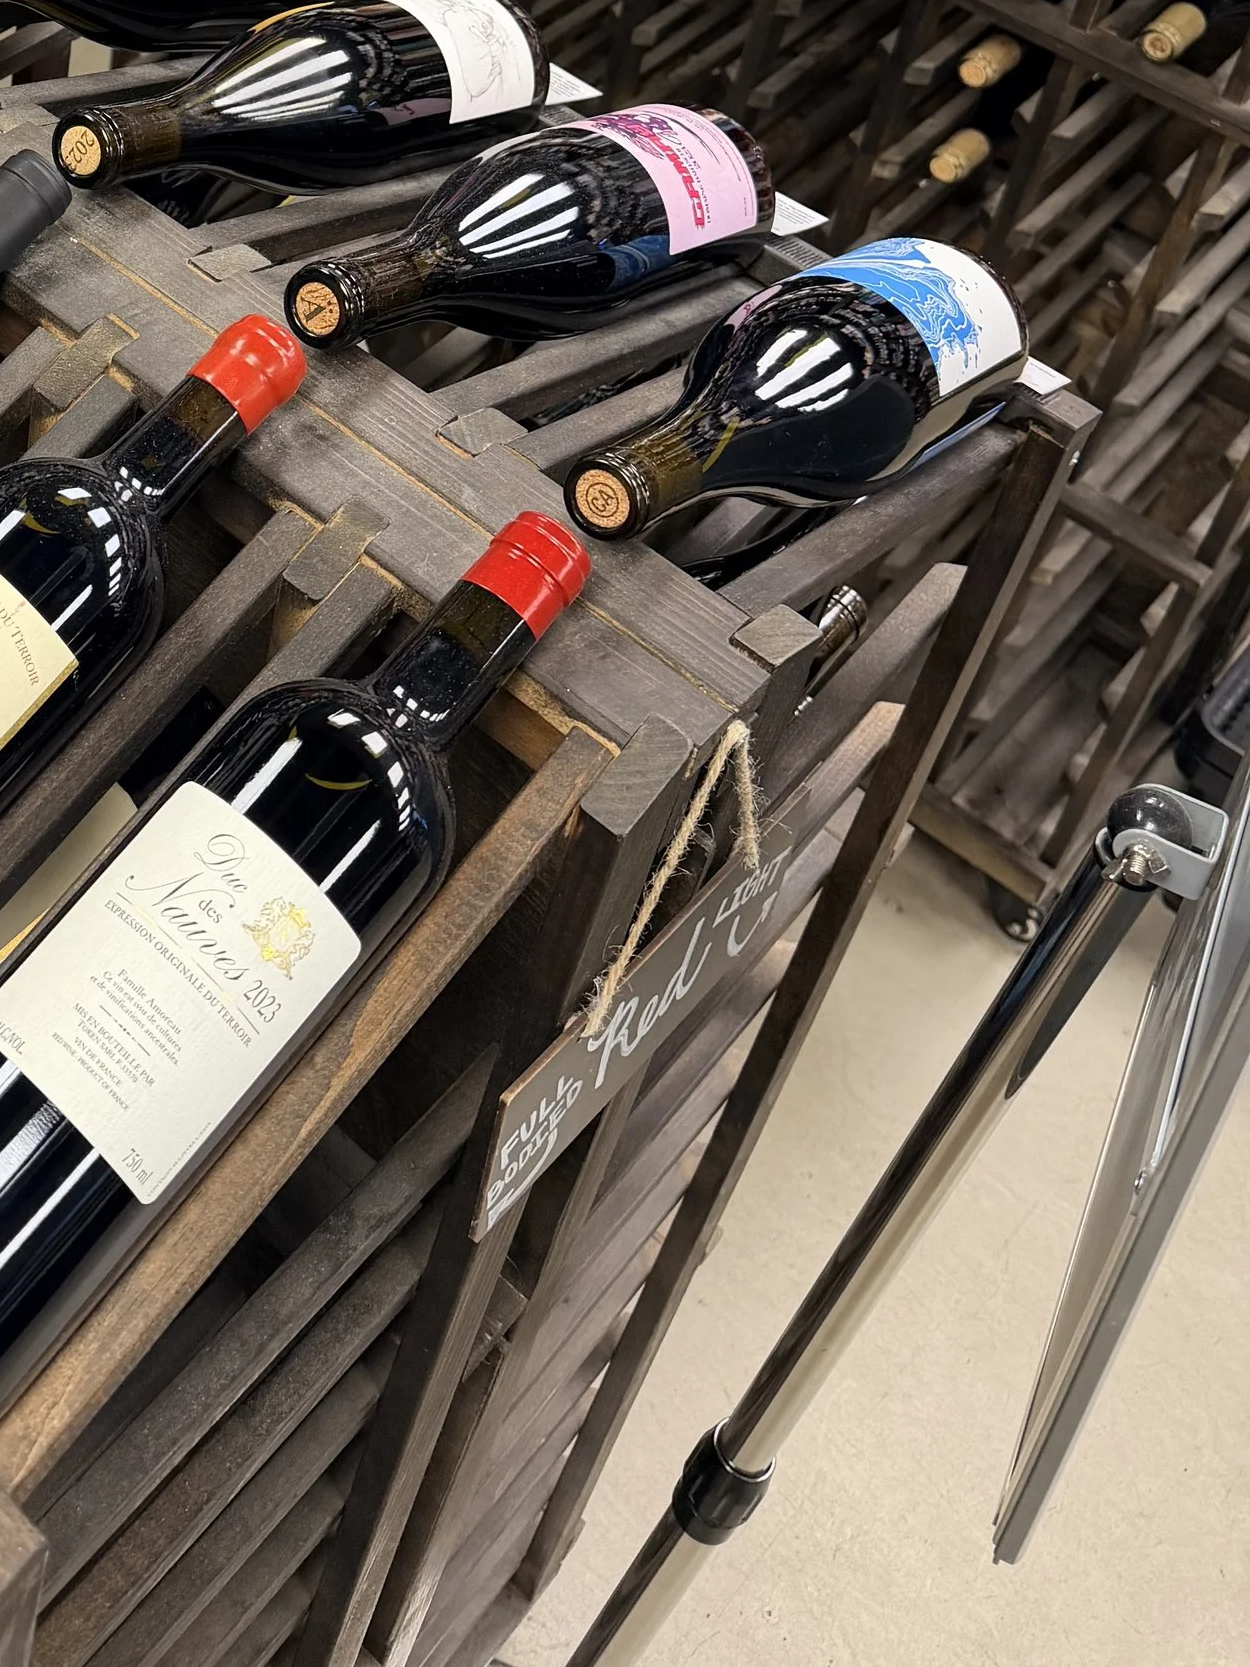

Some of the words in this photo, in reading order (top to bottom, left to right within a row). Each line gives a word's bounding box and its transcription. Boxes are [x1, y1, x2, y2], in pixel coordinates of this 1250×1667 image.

[11, 626, 39, 686] TERROIR
[193, 833, 250, 893] Duc
[712, 846, 794, 927] LIGHT
[124, 872, 271, 981] Nauves
[243, 979, 281, 1023] 2023
[198, 900, 223, 924] des
[104, 900, 156, 943] EXPRESSION
[154, 941, 205, 993] ORIGINALE
[202, 990, 220, 1007] DU
[217, 1004, 251, 1048] TERROIR
[118, 969, 146, 999] Famille
[146, 998, 181, 1035] Amoreau
[587, 919, 713, 1090] Red
[73, 1003, 88, 1018] MIS
[83, 1015, 100, 1029] EN
[97, 1026, 142, 1072] BOUTEILLE
[139, 1069, 155, 1087] PAR
[106, 989, 145, 1029] vinifications
[144, 1028, 178, 1066] ancestrales.
[485, 1078, 584, 1211] BODIED
[499, 1074, 575, 1170] FULL
[122, 1148, 143, 1173] 750
[136, 1169, 154, 1185] ml
